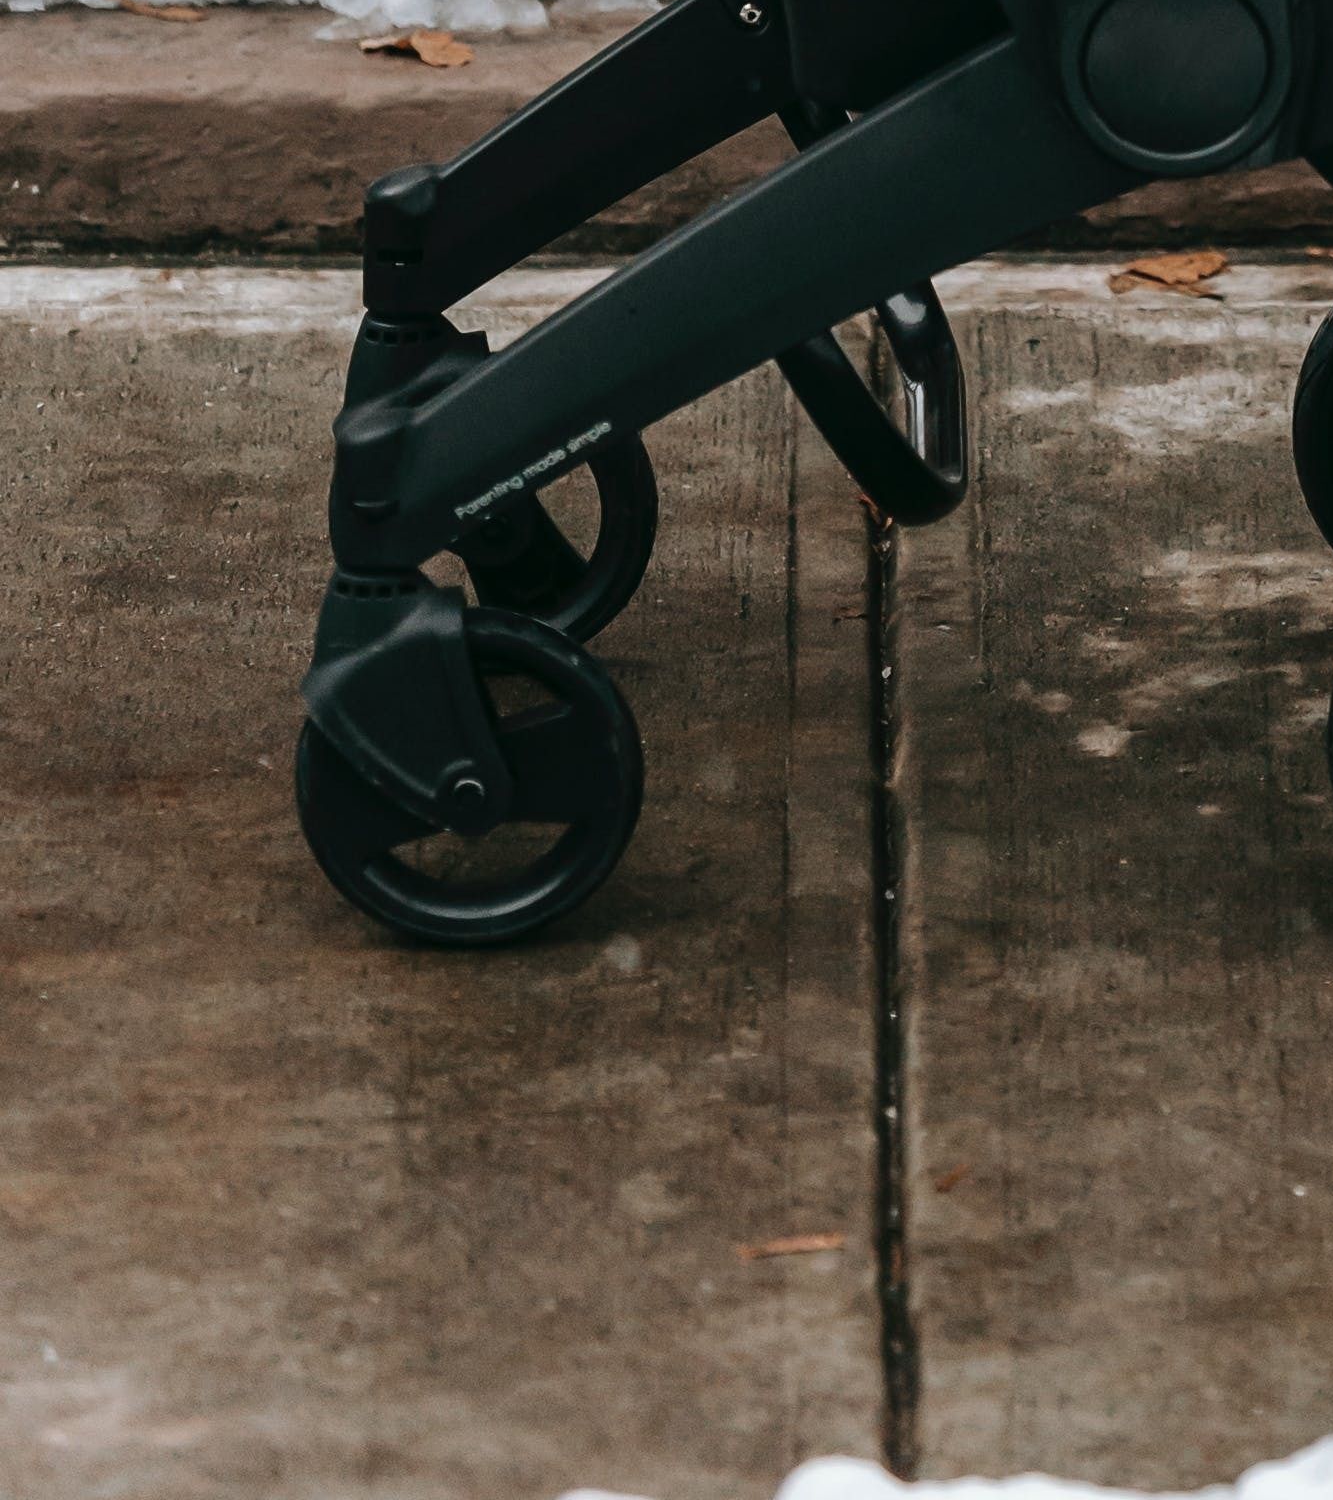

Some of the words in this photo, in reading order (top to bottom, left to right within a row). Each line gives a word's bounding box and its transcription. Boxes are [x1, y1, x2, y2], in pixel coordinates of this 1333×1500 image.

[454, 475, 524, 520] Parenting
[522, 449, 567, 479] made
[567, 421, 612, 453] simple
